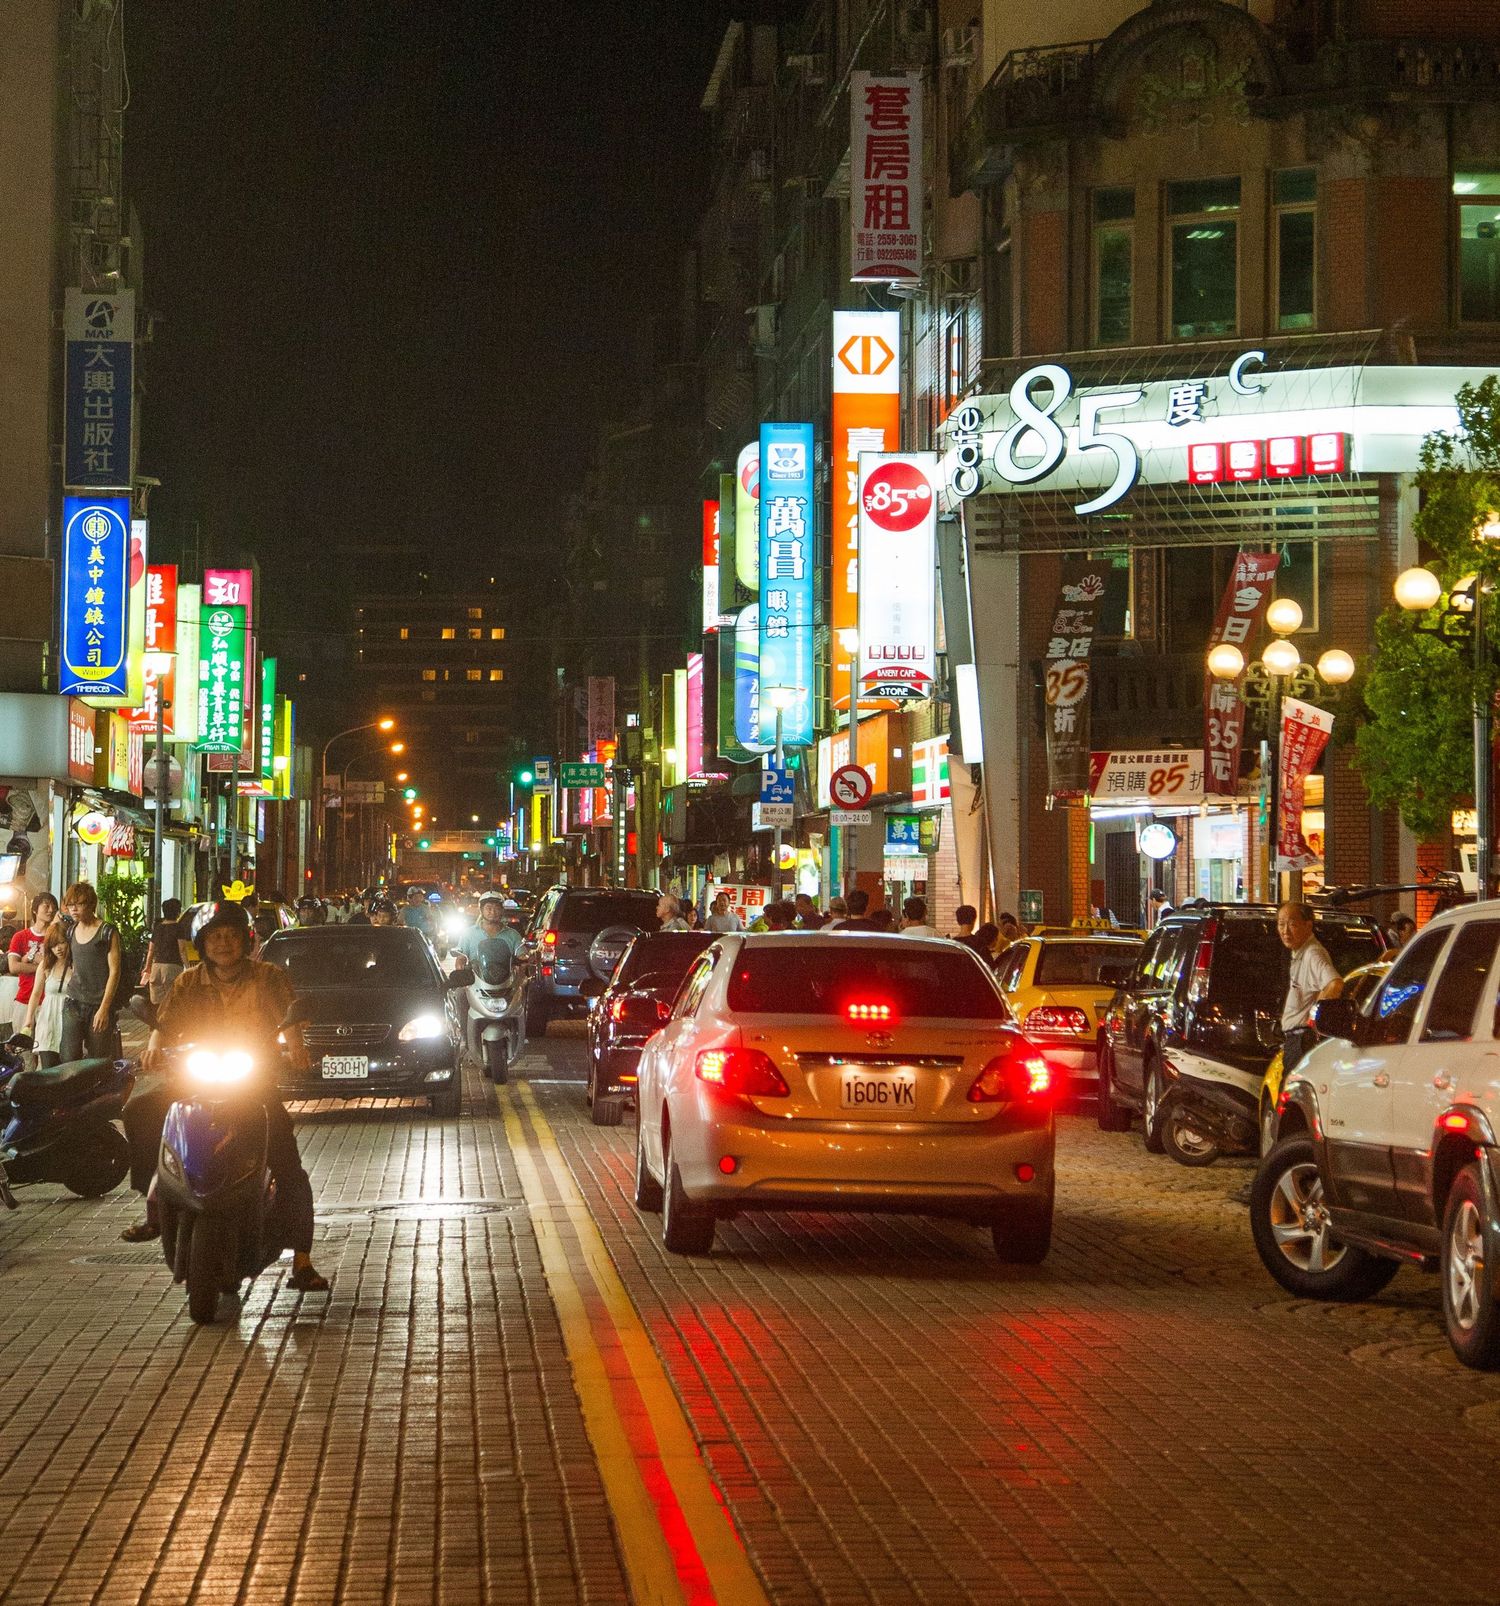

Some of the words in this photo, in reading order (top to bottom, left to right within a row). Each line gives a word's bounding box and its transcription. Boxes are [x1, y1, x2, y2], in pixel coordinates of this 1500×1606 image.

[864, 86, 911, 230] 套房租
[85, 330, 113, 338] MAP
[765, 496, 808, 580] 萬昌
[84, 545, 106, 668] 美中鐘錶公司
[1046, 637, 1092, 658] 全店
[879, 687, 909, 696] STORE
[1055, 708, 1077, 733] 折
[568, 768, 598, 776] 康定路
[762, 771, 778, 792] P
[1078, 919, 1109, 928] TAXI
[845, 1081, 914, 1104] 1606-VK
